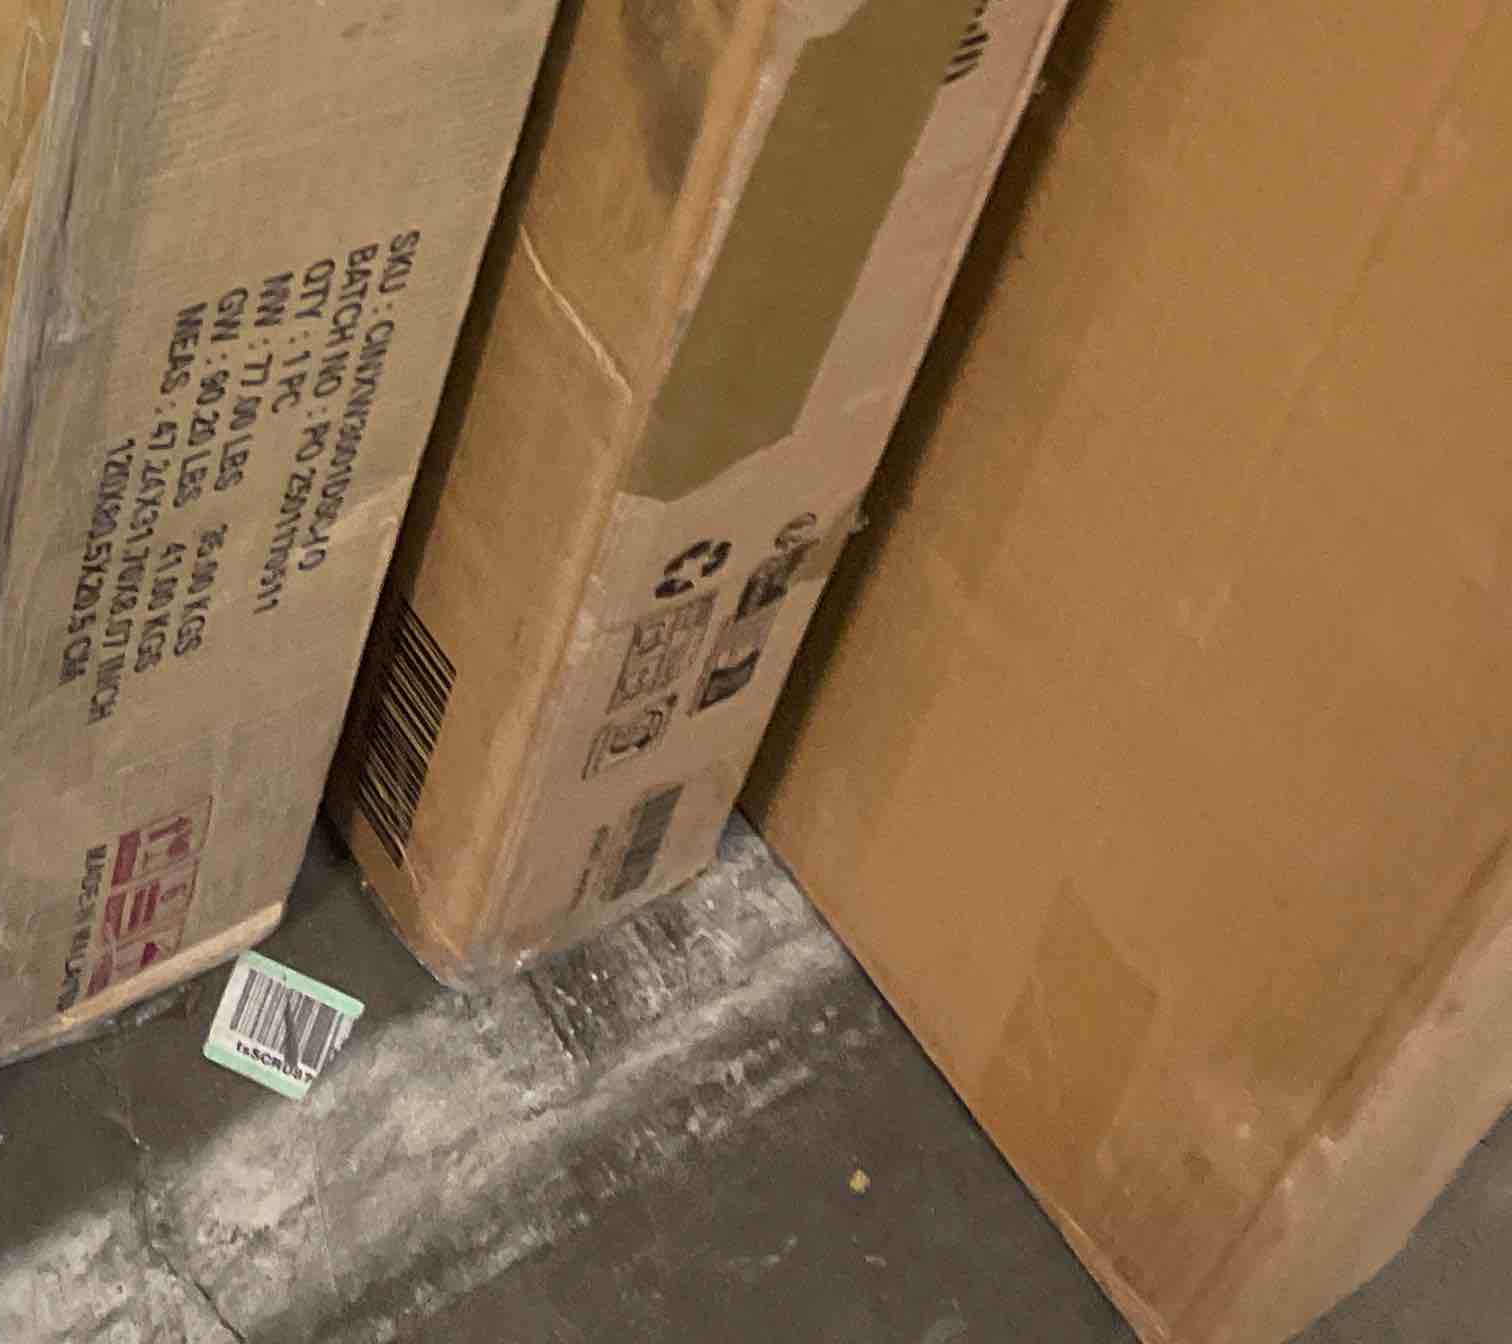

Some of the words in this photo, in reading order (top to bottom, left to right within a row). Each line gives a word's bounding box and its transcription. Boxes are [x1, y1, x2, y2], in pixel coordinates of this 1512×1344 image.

[295, 258, 336, 321] QTY
[379, 230, 421, 294] SKU
[210, 287, 249, 342] GW
[326, 243, 380, 349] BATCH
[160, 302, 208, 395] MEAS
[313, 350, 350, 398] NO
[272, 370, 308, 413] PC
[214, 433, 253, 492] LBS
[295, 419, 331, 464] PO
[173, 450, 212, 510] LBS
[133, 613, 171, 675] KGS
[173, 595, 210, 658] KGS
